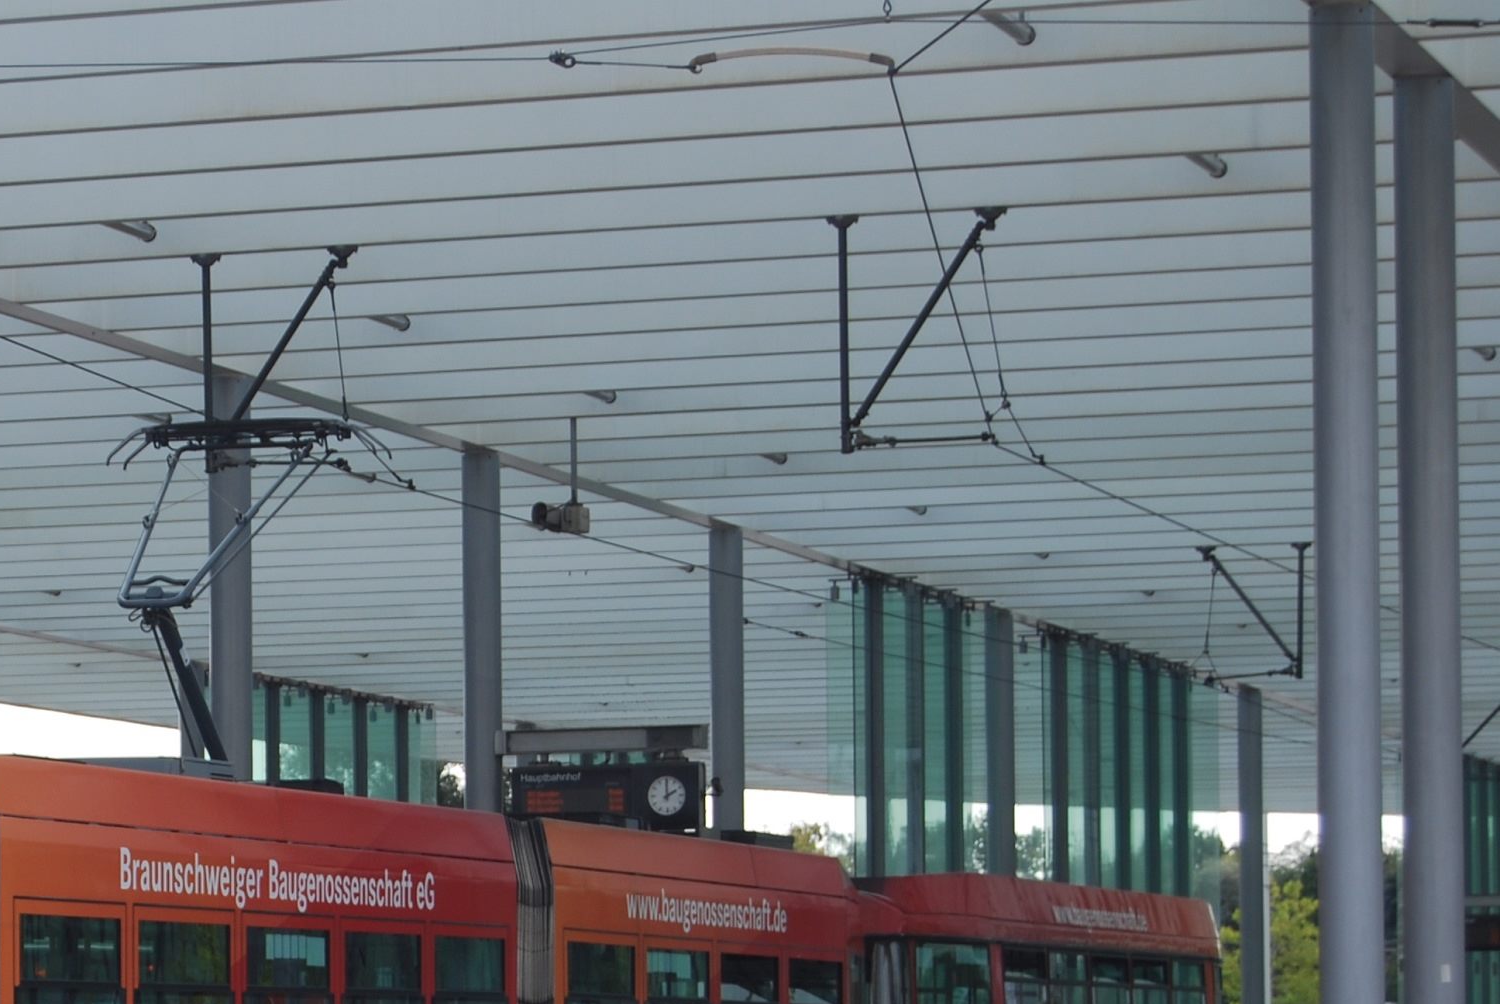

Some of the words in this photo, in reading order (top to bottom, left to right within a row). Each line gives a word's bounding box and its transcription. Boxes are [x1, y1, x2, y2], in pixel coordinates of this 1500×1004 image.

[520, 772, 581, 783] Hauptbahnhof
[119, 847, 263, 909] Braunschweiger
[269, 859, 413, 913] Baugenossenschaft
[417, 871, 436, 911] eG
[626, 888, 788, 934] www.baugenossenschaft.de
